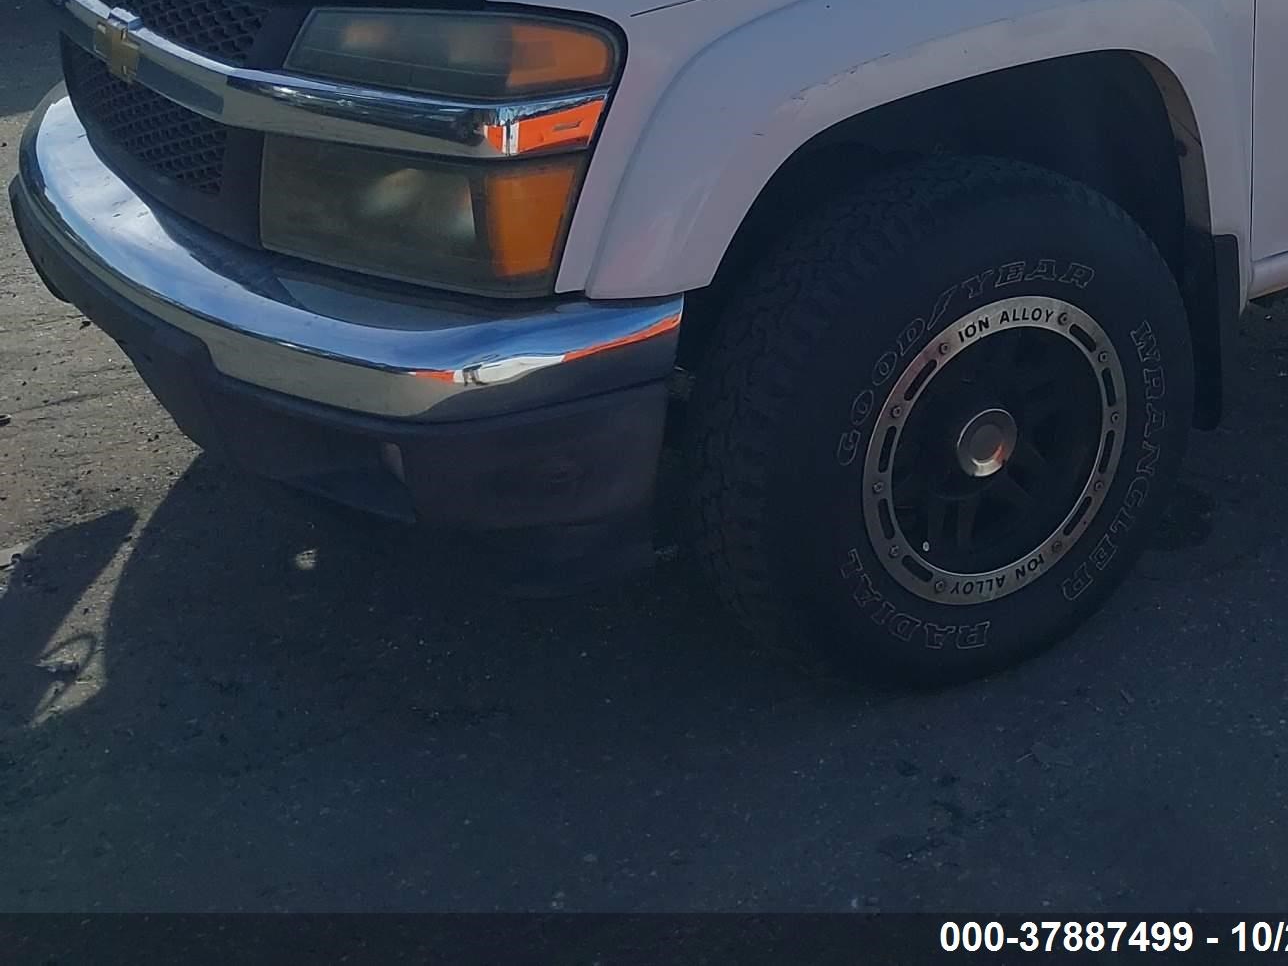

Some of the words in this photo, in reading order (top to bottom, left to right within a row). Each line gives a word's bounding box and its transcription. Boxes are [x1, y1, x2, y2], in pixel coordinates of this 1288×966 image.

[958, 317, 990, 343] ION
[1000, 307, 1055, 324] ALLOY
[1061, 320, 1167, 600] WRANGLER
[950, 574, 1006, 595] ALLOY
[1015, 554, 1045, 580] ION
[840, 548, 990, 650] RADIAL
